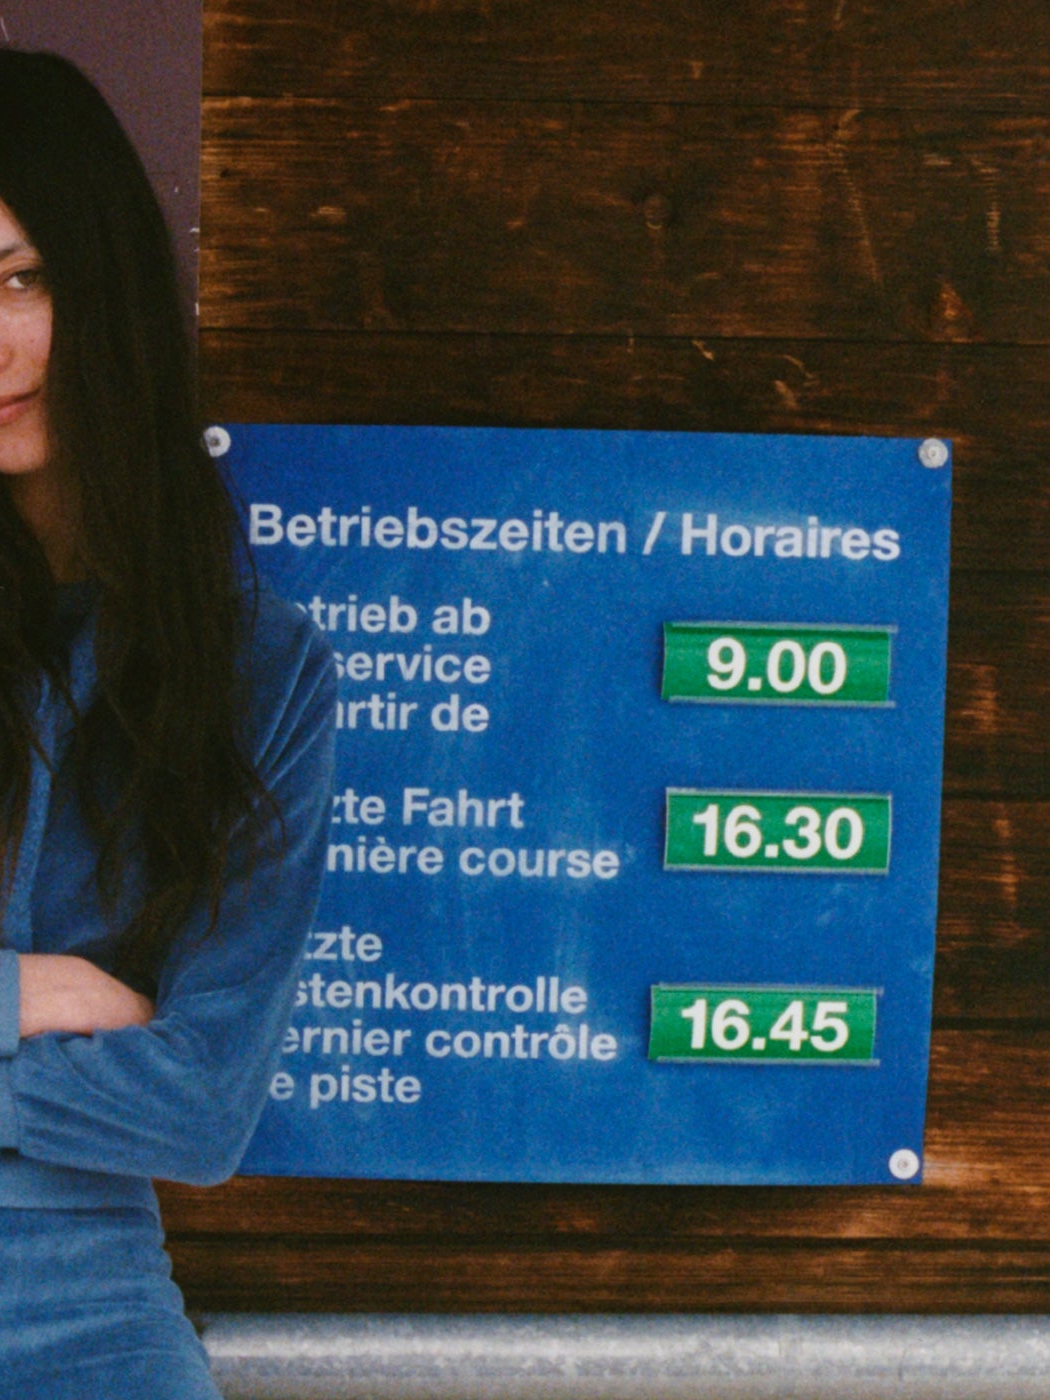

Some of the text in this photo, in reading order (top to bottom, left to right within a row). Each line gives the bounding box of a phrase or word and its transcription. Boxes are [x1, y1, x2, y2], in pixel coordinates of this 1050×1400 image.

[249, 503, 902, 562] Betriebszeiten / Horaires
[297, 594, 492, 636] trieb ab
[706, 636, 848, 696] 9.00
[430, 694, 490, 733] de
[402, 787, 525, 829] Fahrt
[692, 803, 865, 861] 16.30
[326, 835, 621, 880] nière course
[304, 925, 383, 963] zte
[425, 1022, 619, 1062] contrôle
[680, 997, 850, 1053] 16.45
[309, 1064, 422, 1109] piste
